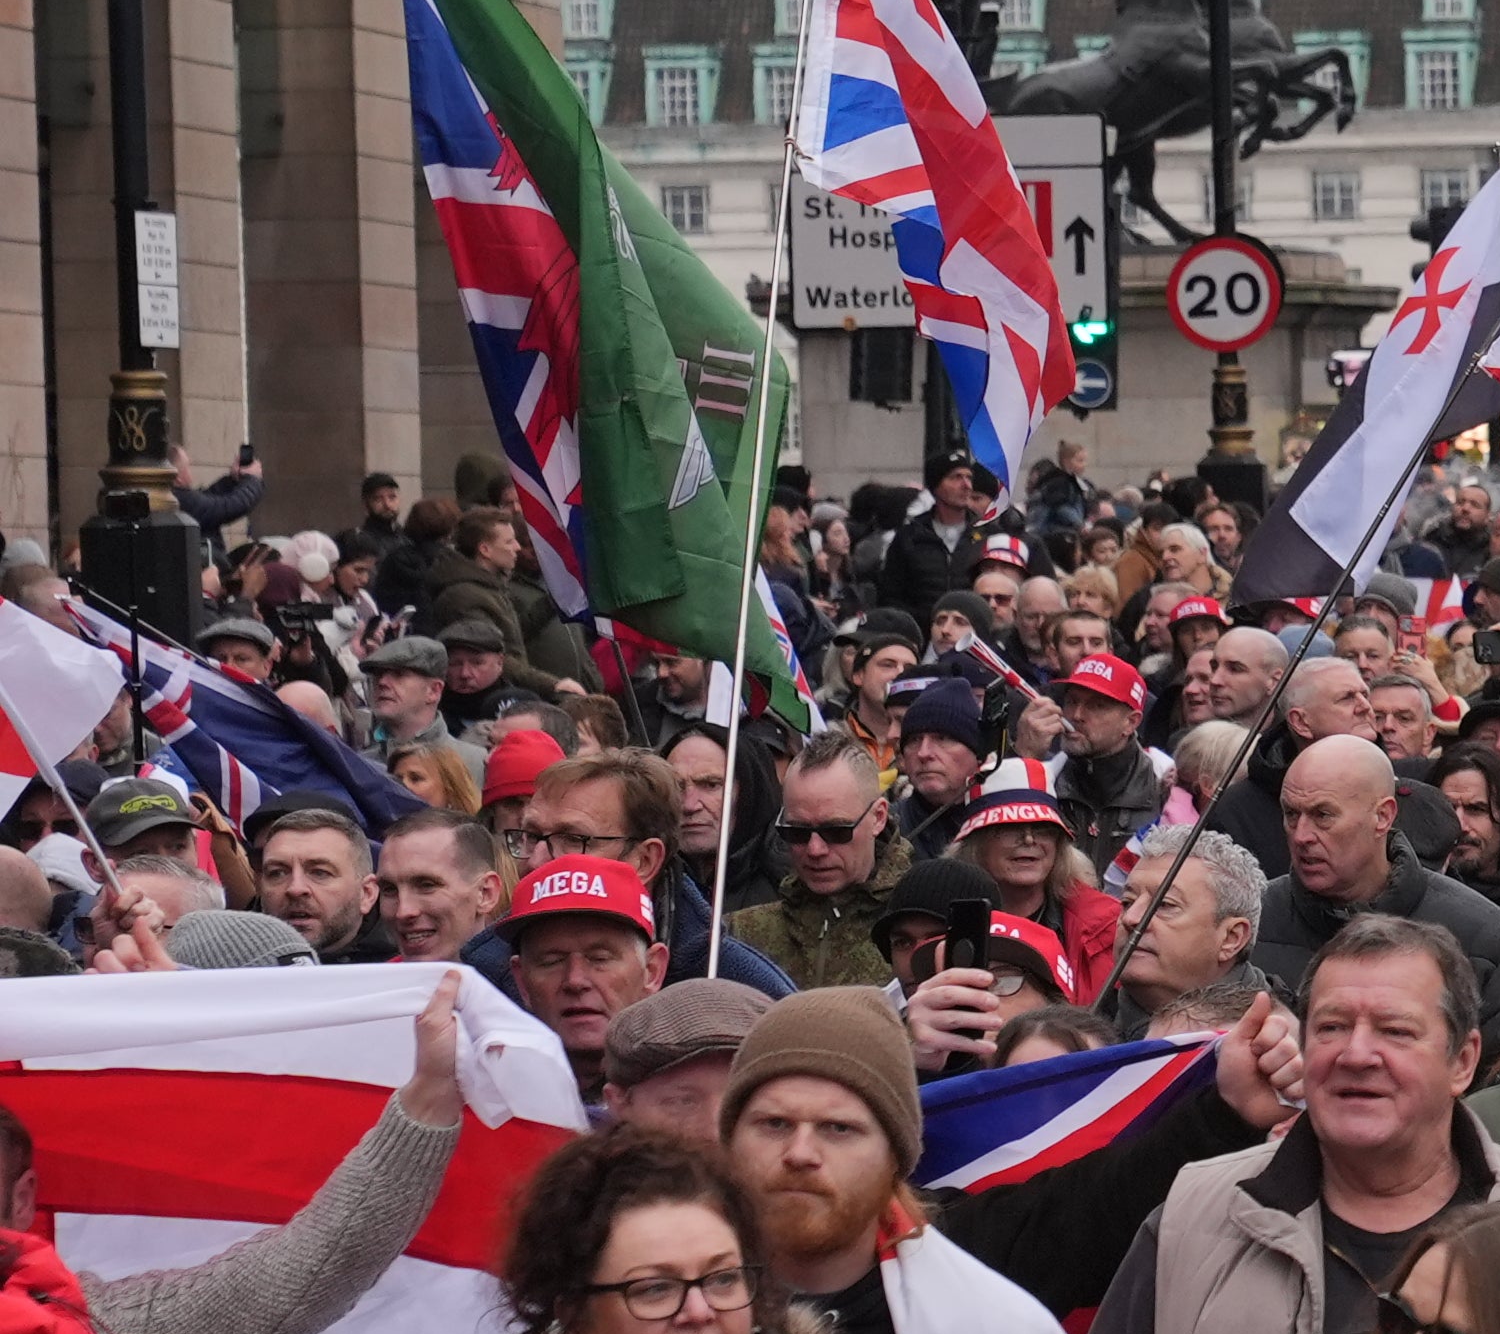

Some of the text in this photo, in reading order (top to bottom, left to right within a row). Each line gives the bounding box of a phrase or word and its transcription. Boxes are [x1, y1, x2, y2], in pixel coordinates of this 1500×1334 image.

[803, 197, 844, 220] St.
[1185, 272, 1261, 318] 20
[1076, 659, 1113, 682] MEGA
[530, 871, 608, 904] MEGA
